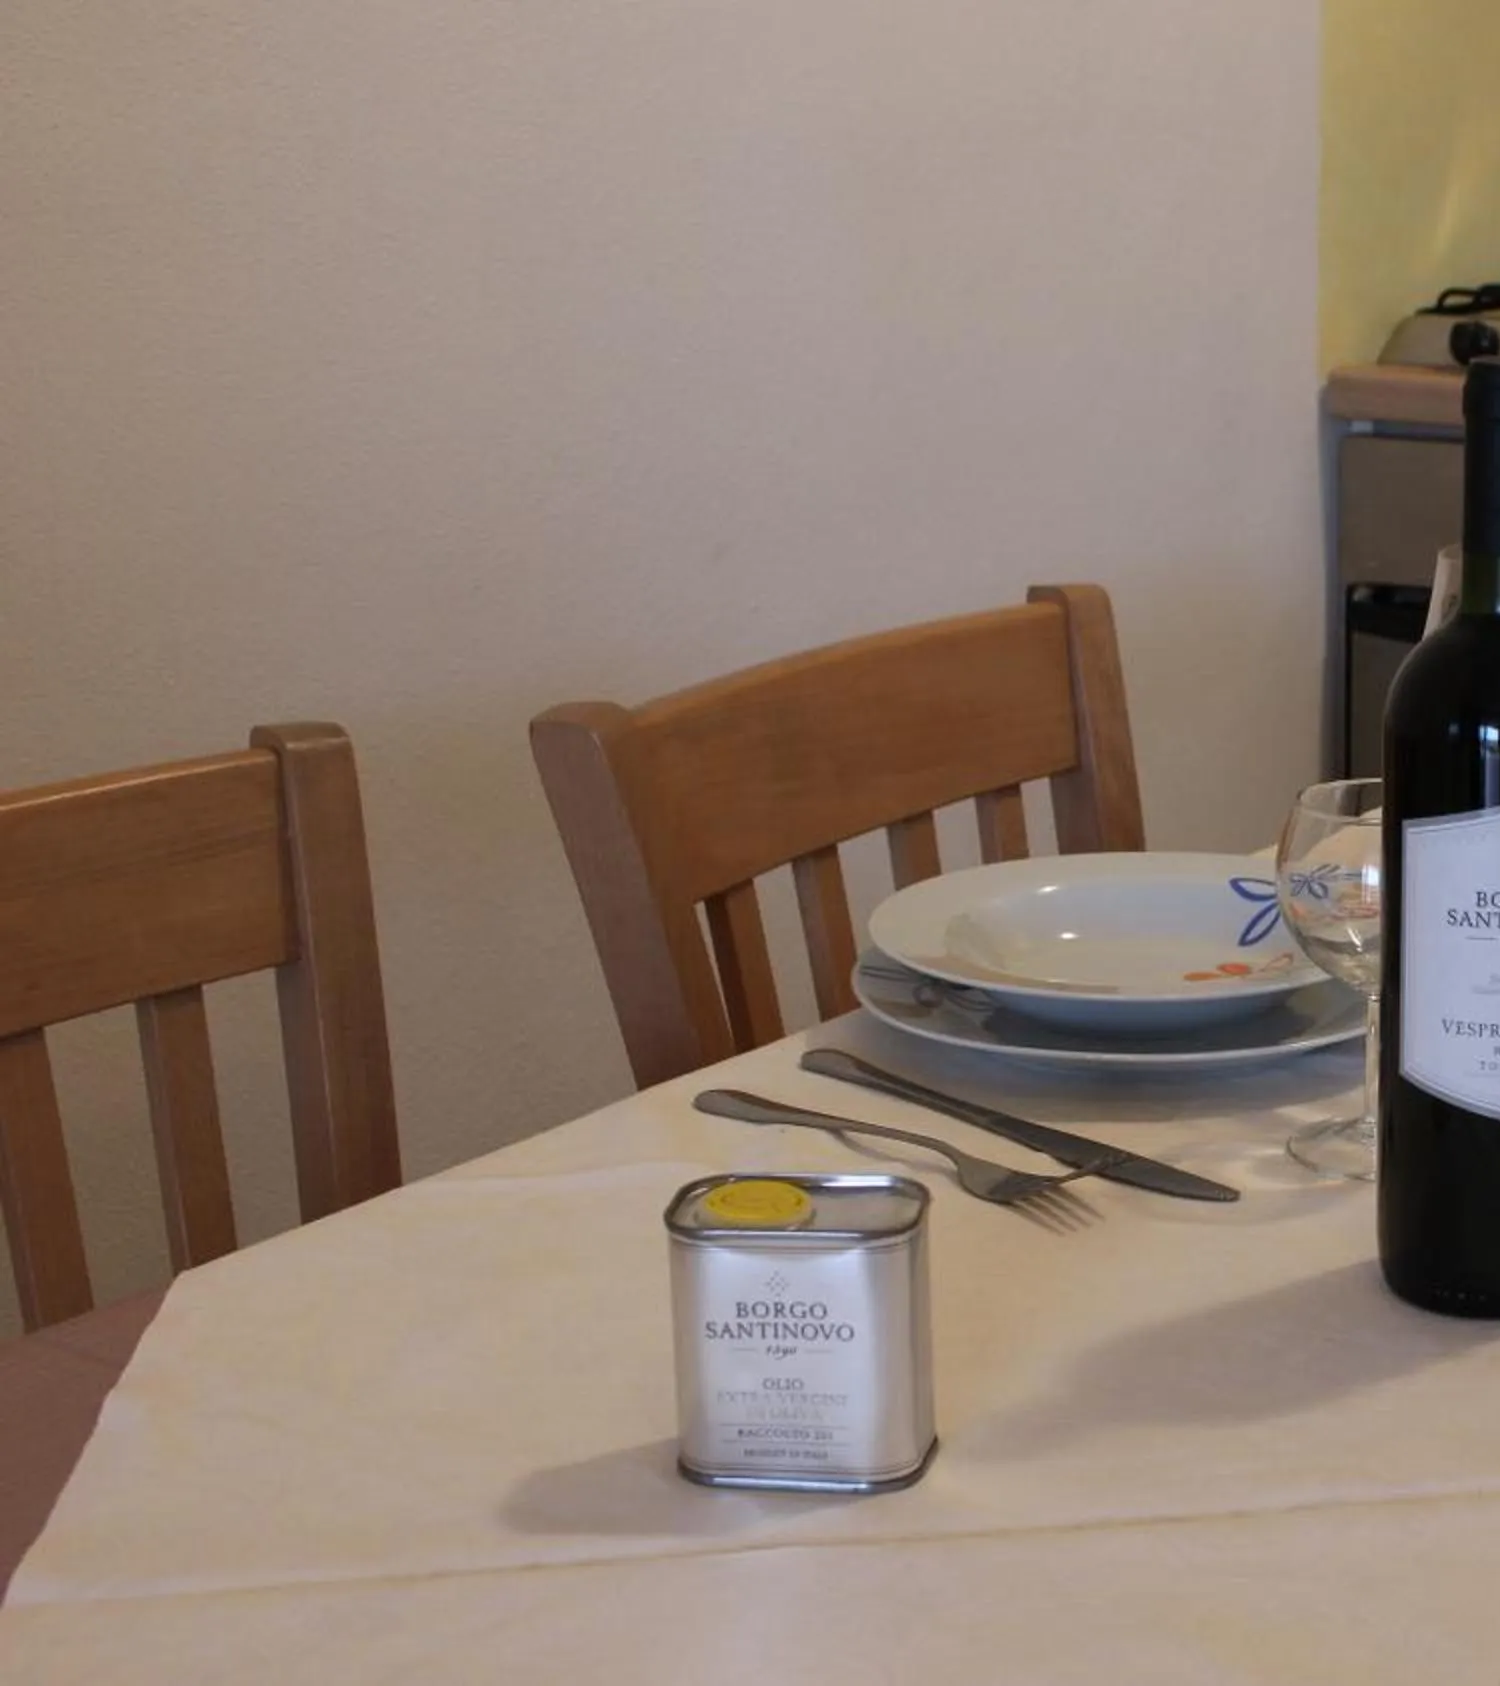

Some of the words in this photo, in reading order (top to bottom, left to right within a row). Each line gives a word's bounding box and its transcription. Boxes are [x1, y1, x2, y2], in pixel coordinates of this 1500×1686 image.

[735, 1301, 828, 1320] BORGO
[704, 1321, 855, 1342] SANTINOVO
[762, 1377, 804, 1390] OLIO
